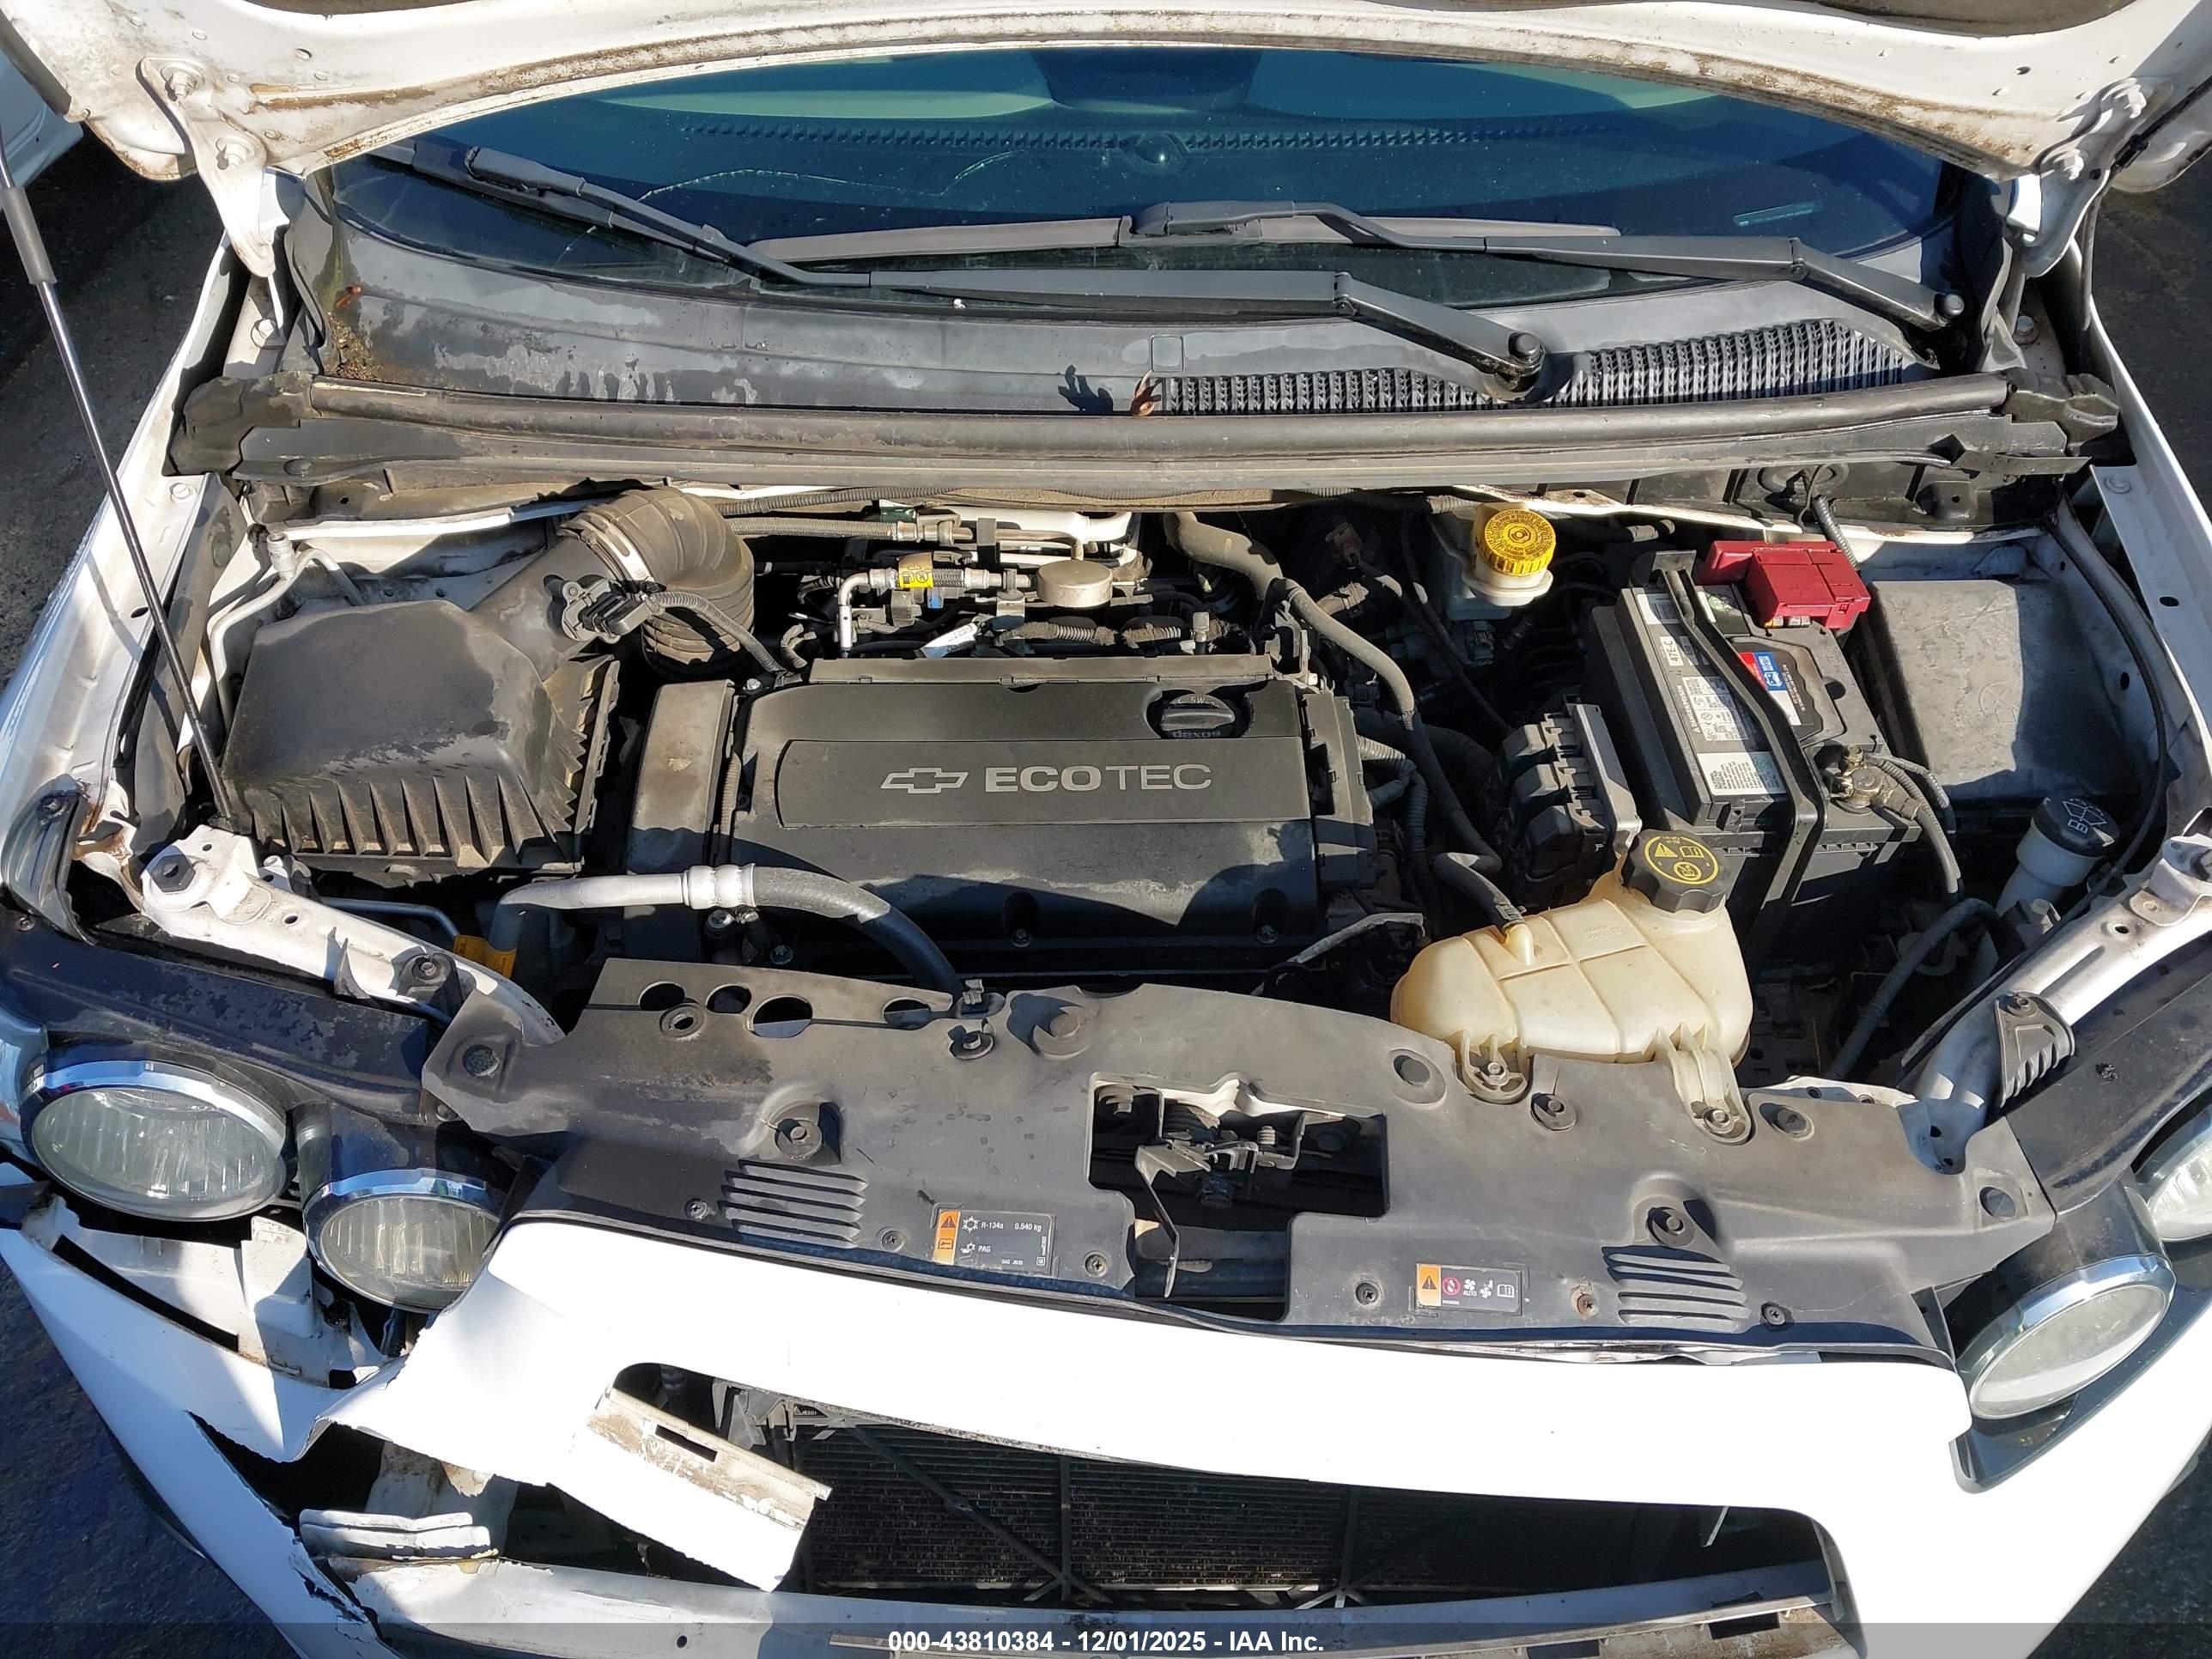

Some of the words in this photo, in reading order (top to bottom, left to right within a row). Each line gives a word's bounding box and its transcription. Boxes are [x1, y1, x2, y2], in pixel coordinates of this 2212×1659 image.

[1663, 640, 1679, 662] 47E-C
[985, 764, 1212, 793] ECOTEC
[981, 1221, 1004, 1230] R-134a
[1014, 1222, 1032, 1231] 0.540
[1033, 1223, 1042, 1233] kg
